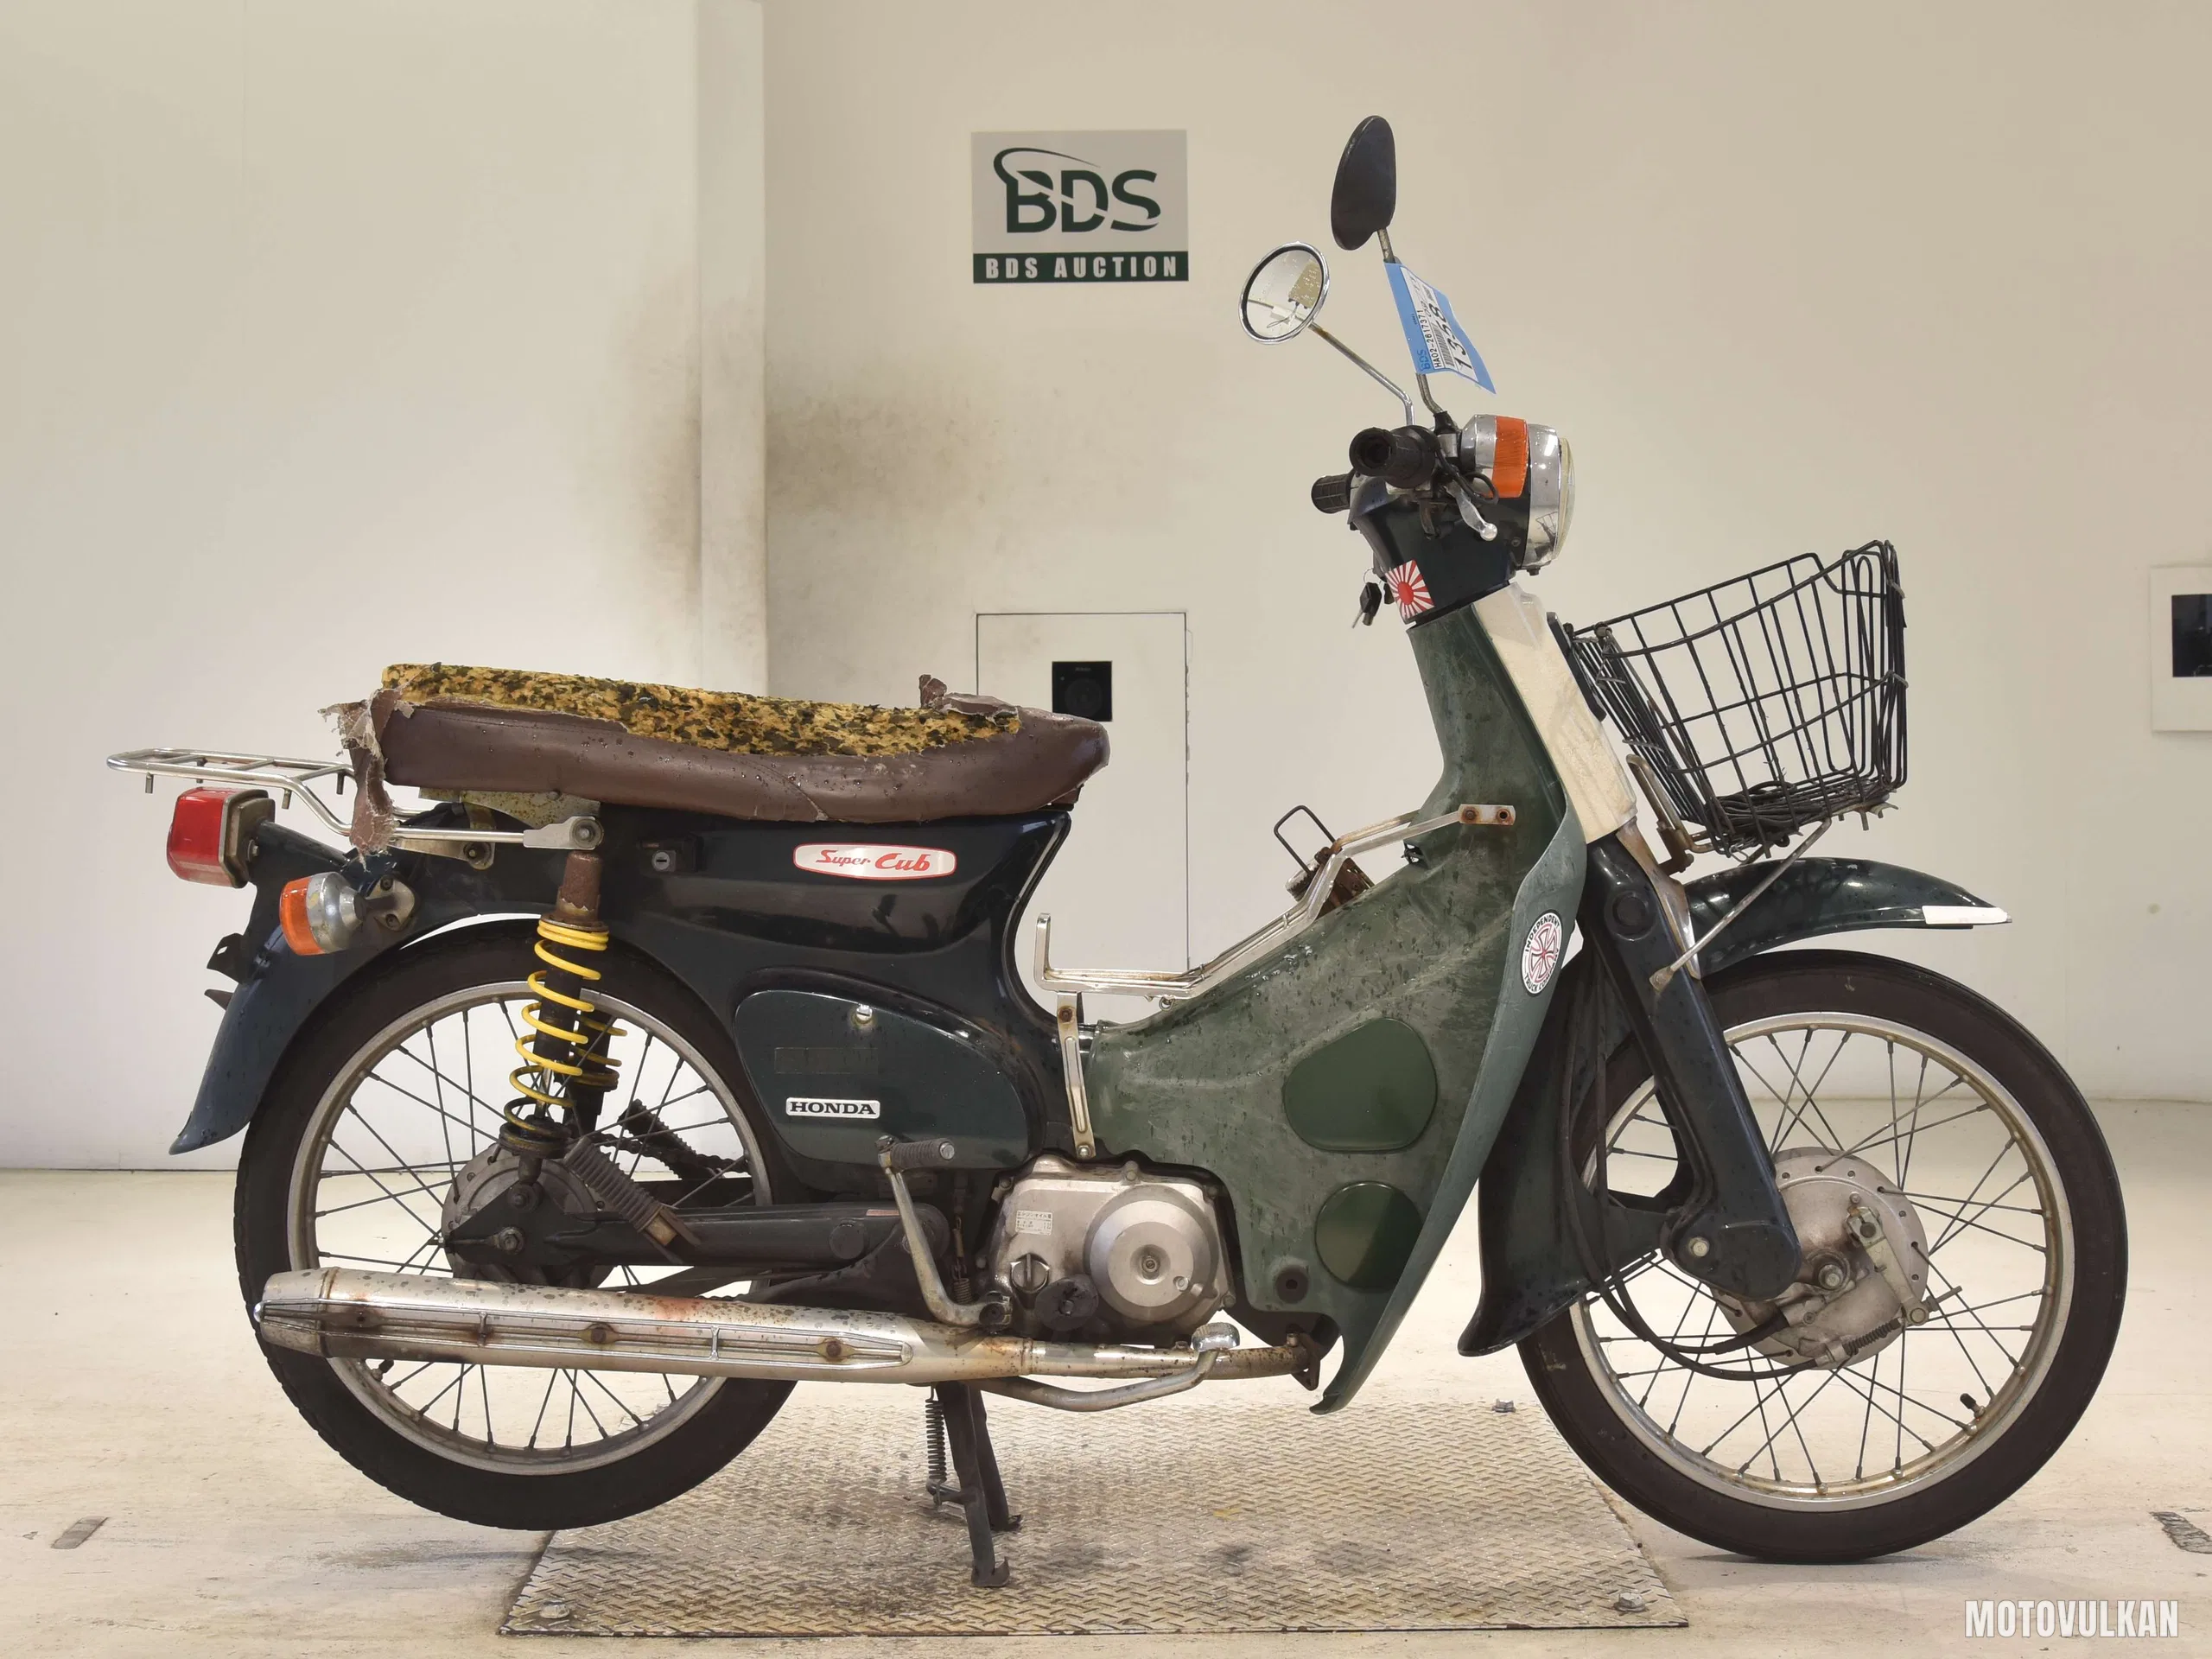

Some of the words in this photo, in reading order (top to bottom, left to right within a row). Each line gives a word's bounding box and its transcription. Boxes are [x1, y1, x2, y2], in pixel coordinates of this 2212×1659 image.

[994, 148, 1161, 232] BDS
[985, 257, 1038, 278] BDS
[1054, 256, 1176, 278] AUCTION
[1428, 303, 1472, 370] 1358
[1417, 349, 1431, 371] BDS
[816, 849, 871, 867] Super
[874, 853, 931, 872] Cub
[1525, 915, 1560, 952] INDEPENDENT
[1524, 972, 1537, 992] TRUCK
[1538, 948, 1559, 990] COMY
[790, 1102, 876, 1115] HONDA
